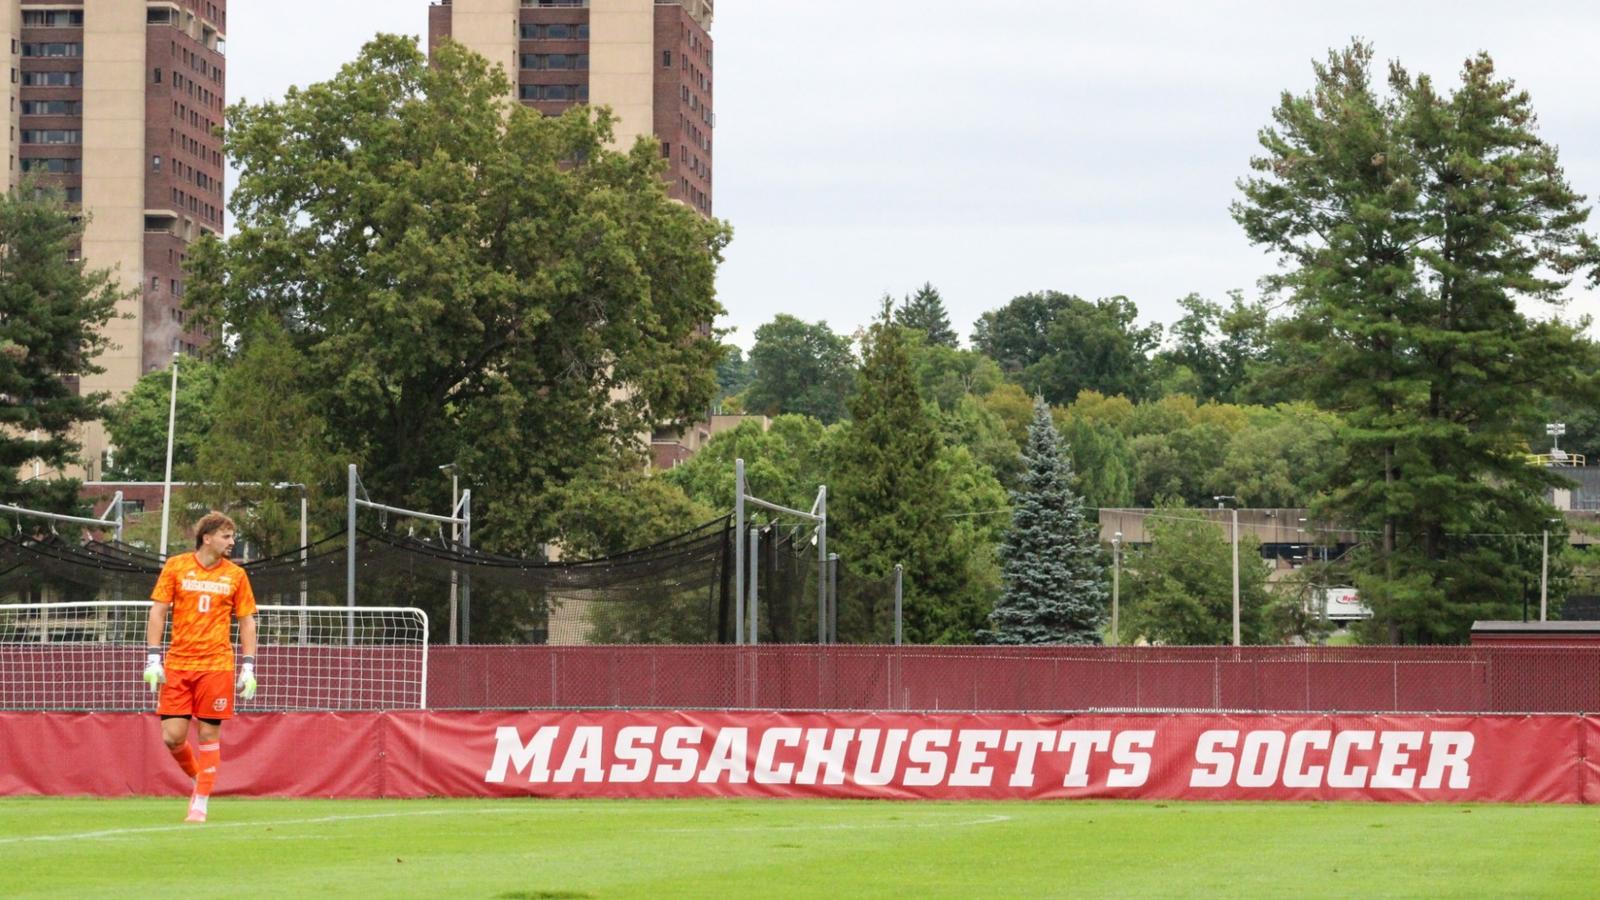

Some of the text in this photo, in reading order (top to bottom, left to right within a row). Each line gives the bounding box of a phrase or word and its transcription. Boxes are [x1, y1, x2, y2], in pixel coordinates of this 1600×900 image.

[198, 594, 210, 613] 0
[484, 725, 1476, 790] MASSACHUSETTS SOCCER
